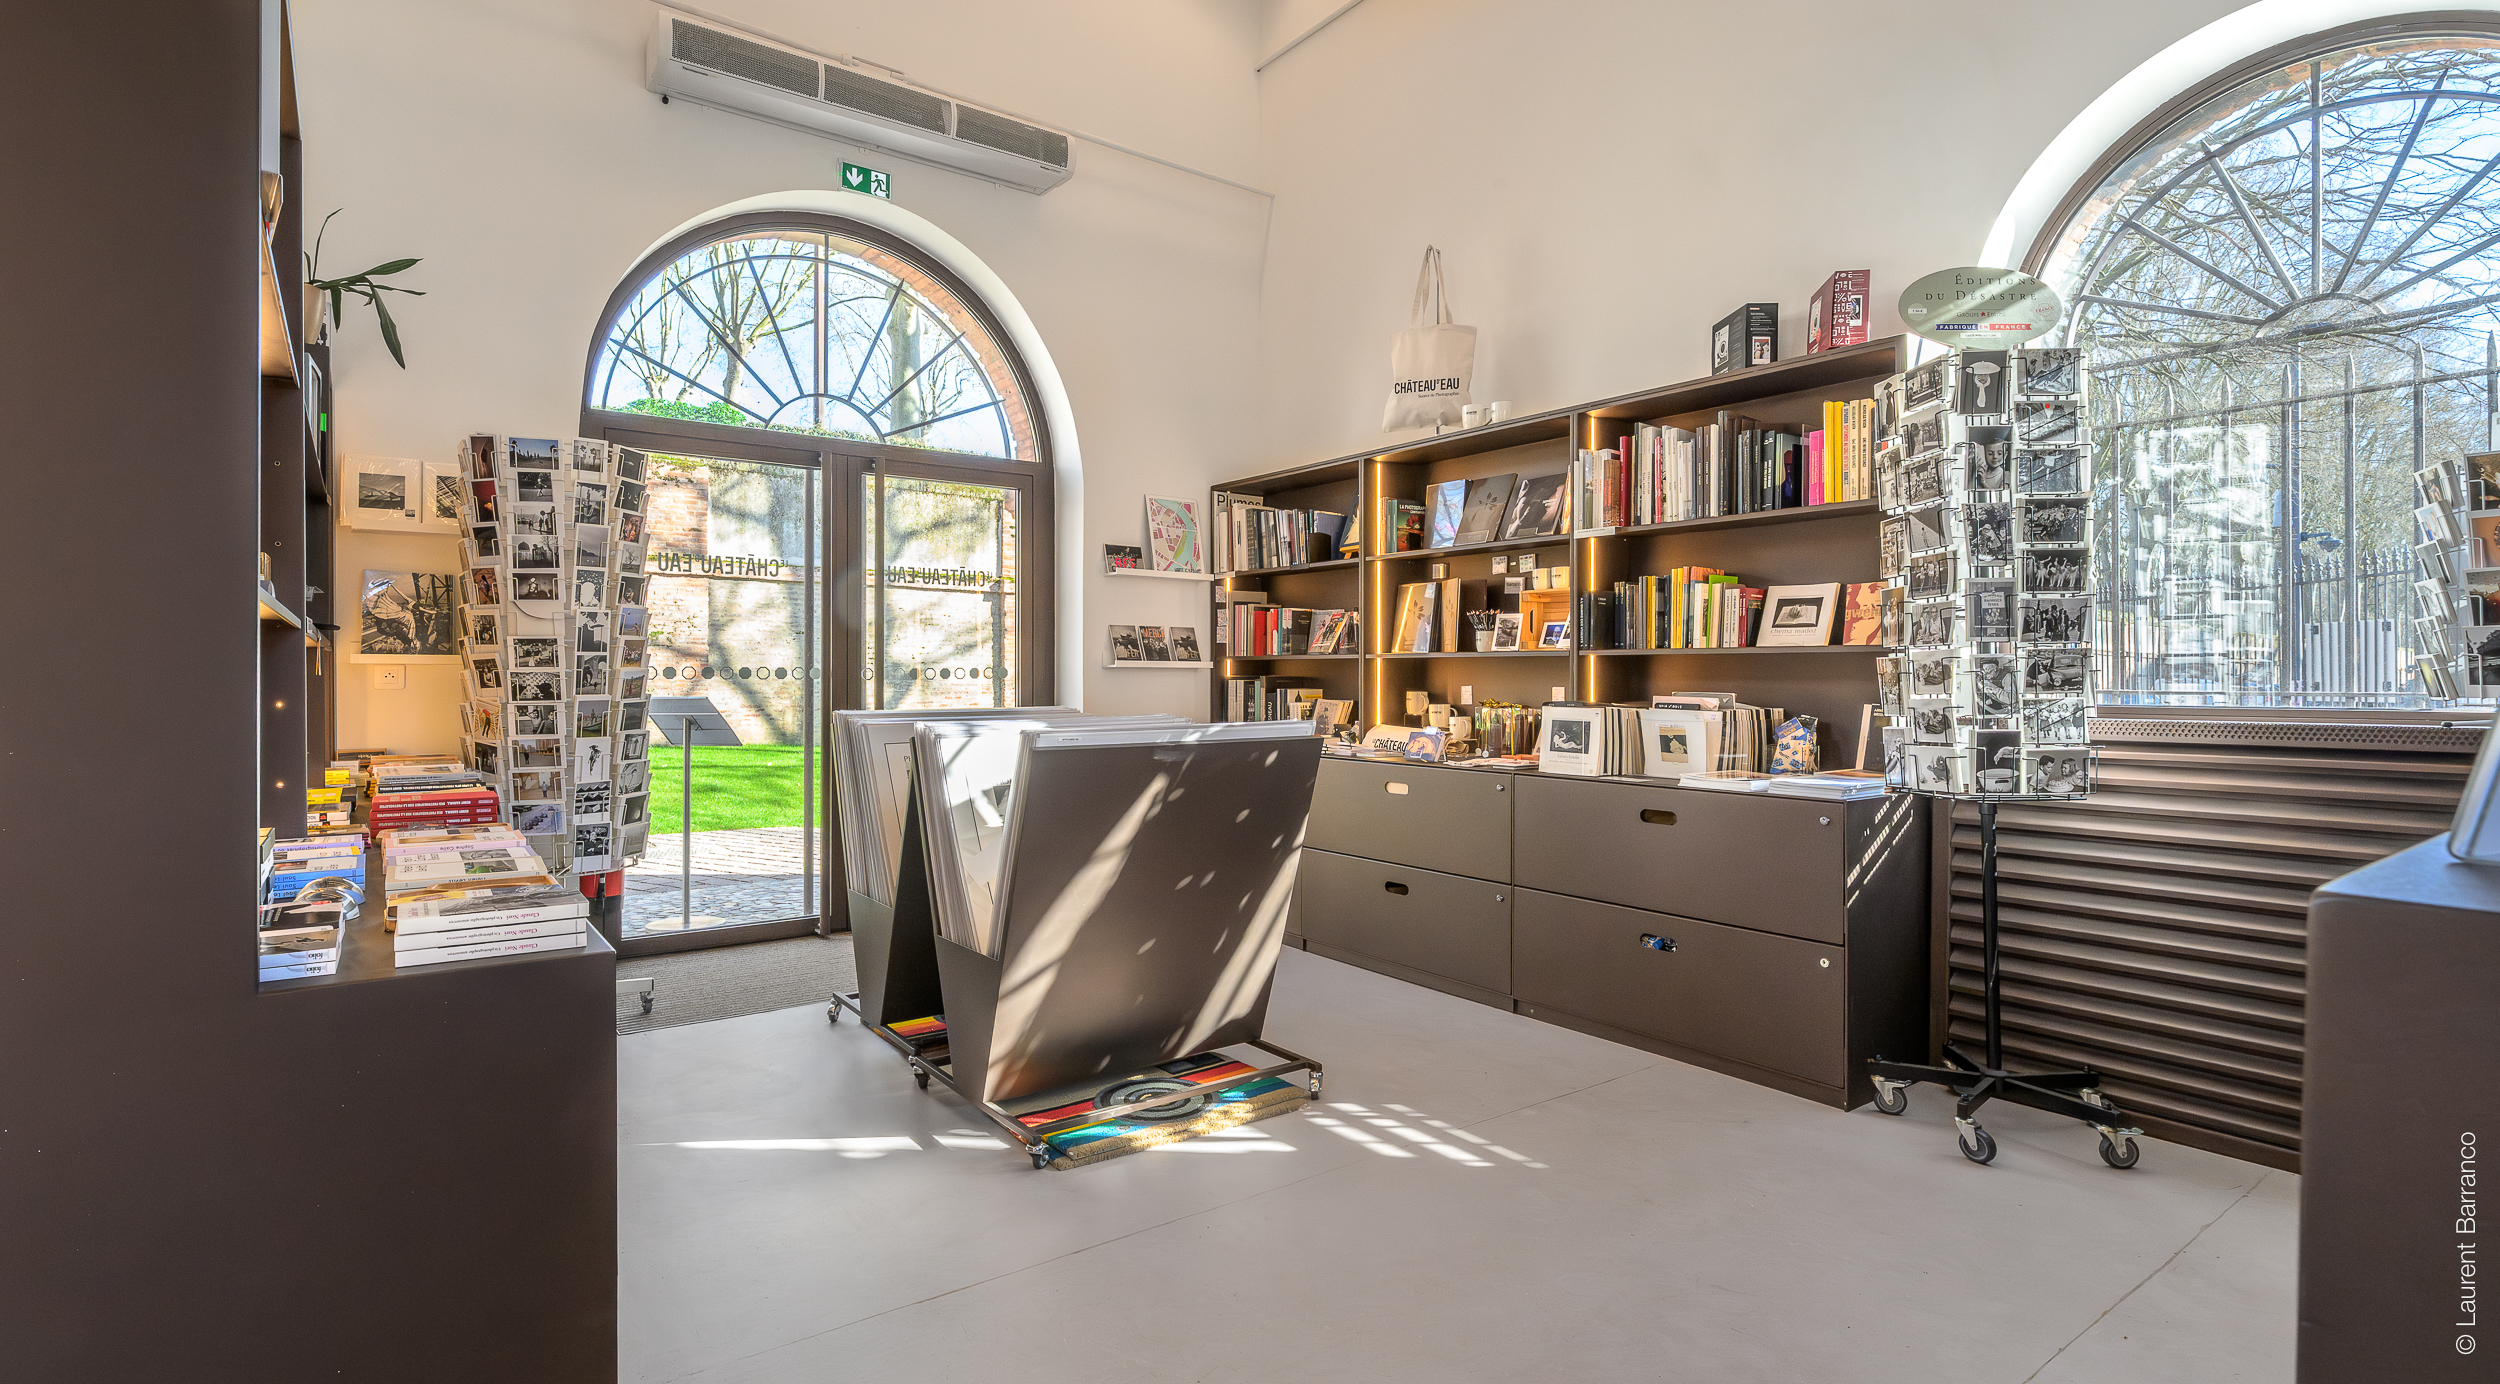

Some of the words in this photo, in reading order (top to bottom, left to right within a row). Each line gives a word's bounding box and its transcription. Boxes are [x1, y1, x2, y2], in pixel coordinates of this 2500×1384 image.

[1954, 273, 2037, 286] ÉDITIONS
[1925, 292, 1945, 301] DU
[1955, 290, 2037, 301] DÉSASTRE
[308, 951, 324, 960] folio
[306, 965, 322, 974] folio
